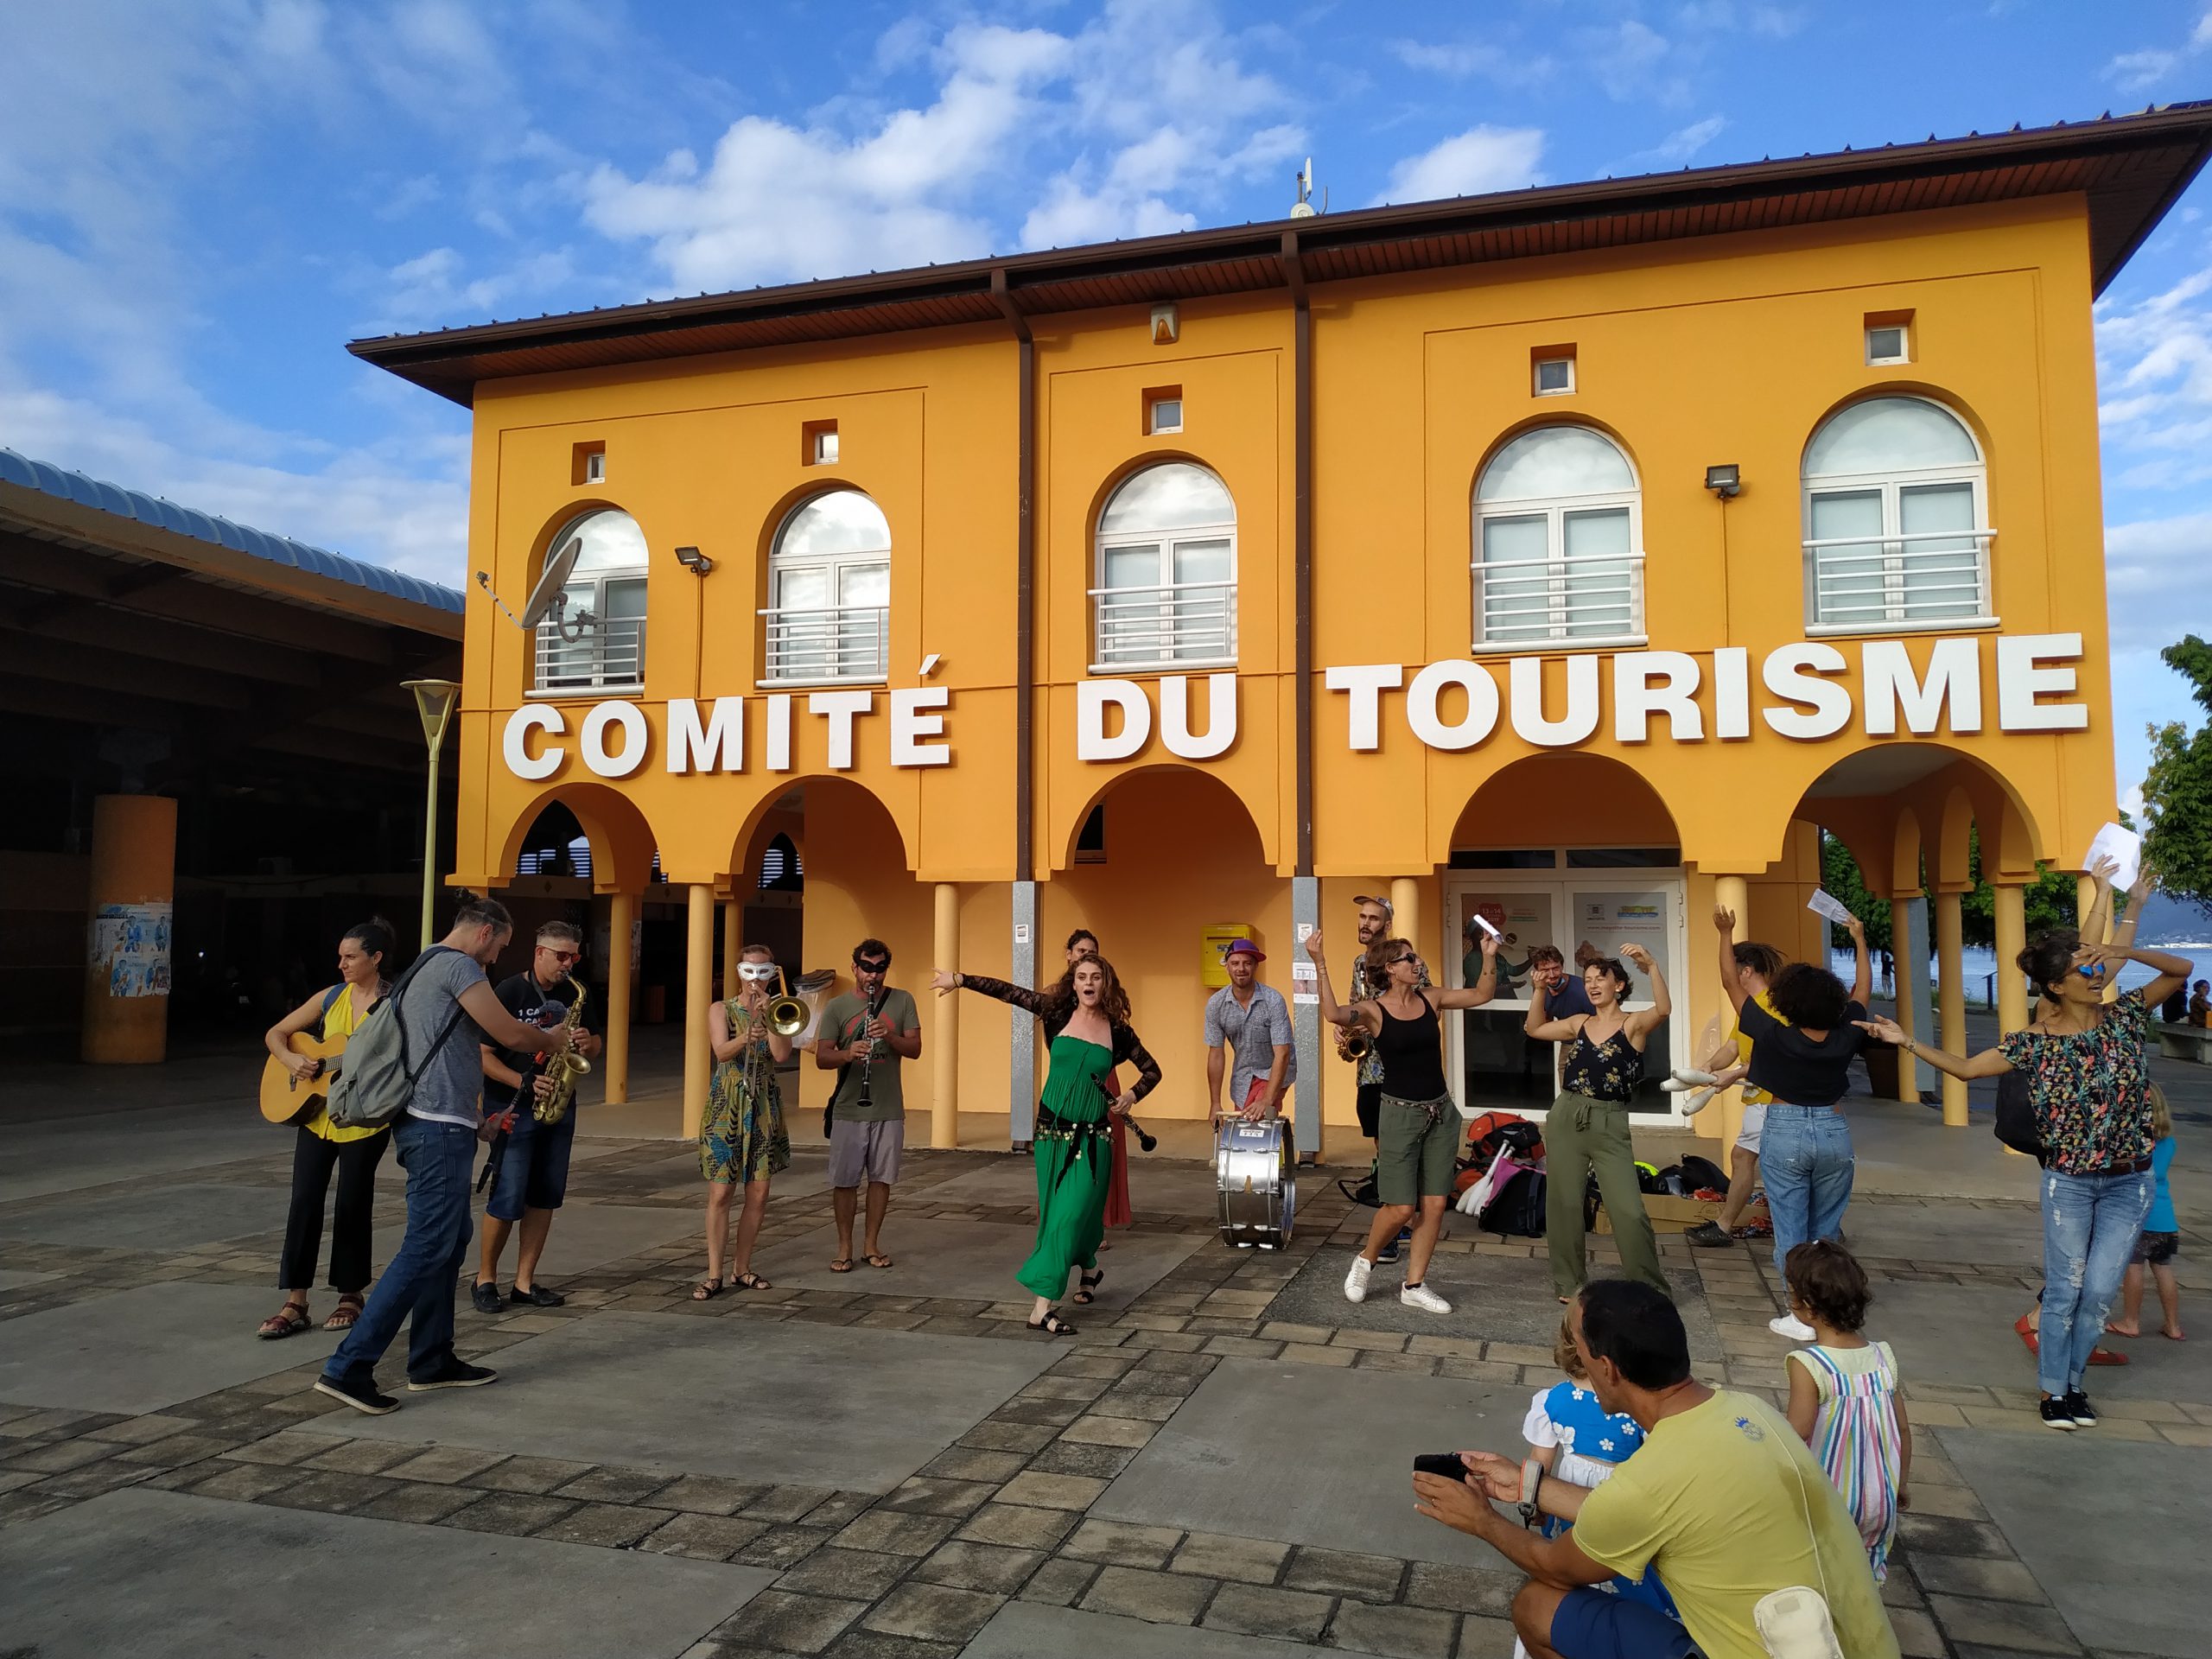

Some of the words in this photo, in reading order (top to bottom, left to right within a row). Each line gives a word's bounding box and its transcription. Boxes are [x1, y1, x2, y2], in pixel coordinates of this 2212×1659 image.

[503, 653, 950, 779] COMITÉ
[1077, 673, 1236, 760] DU
[1325, 632, 2088, 749] TOURISME
